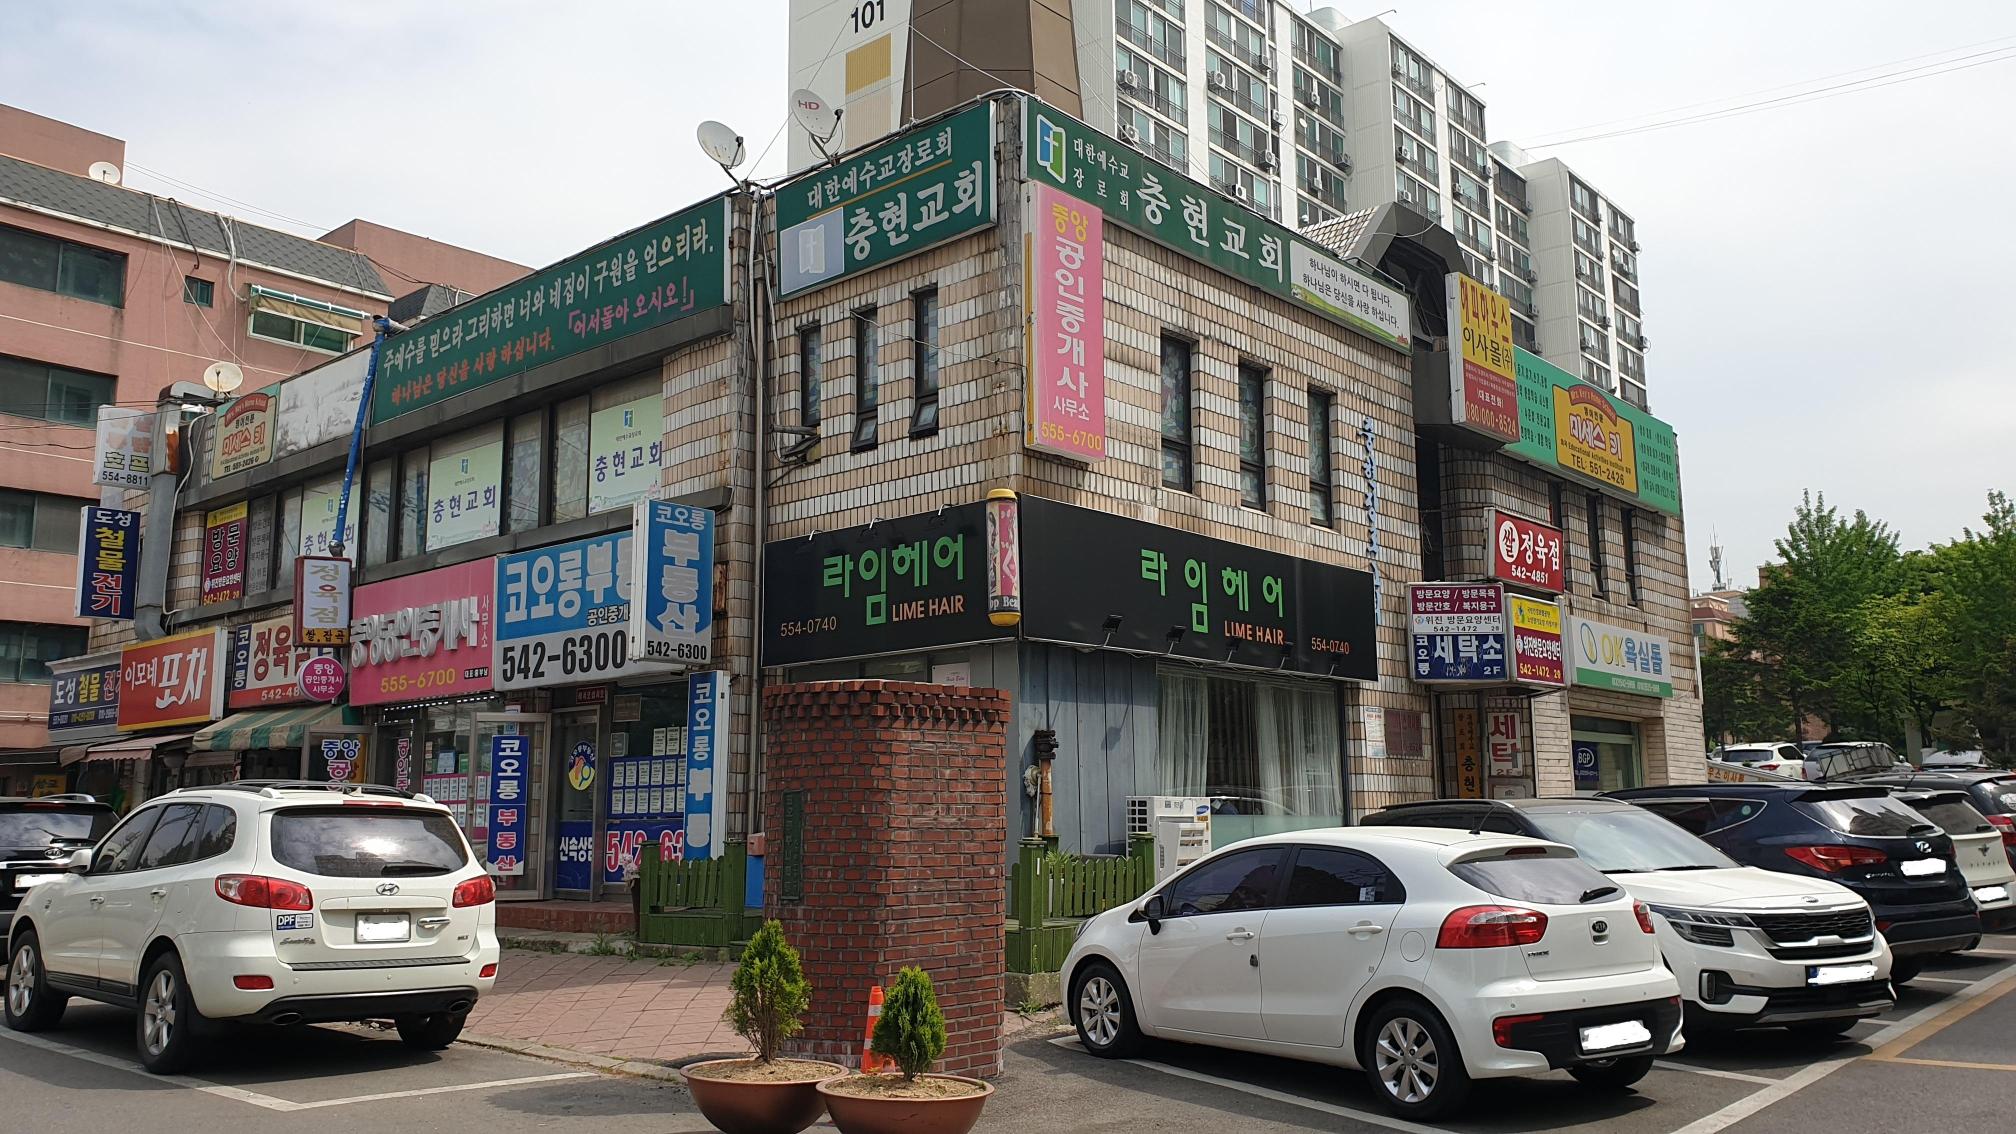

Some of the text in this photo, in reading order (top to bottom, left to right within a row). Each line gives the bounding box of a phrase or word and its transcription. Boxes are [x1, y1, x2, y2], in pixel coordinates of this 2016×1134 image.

[851, 0, 886, 34] 101
[798, 100, 820, 111] HD
[807, 126, 952, 209] 대한예수교장로회
[1073, 138, 1130, 180] 대한예수교
[845, 160, 983, 261] 충현교회
[1052, 203, 1089, 242] 중앙
[1136, 173, 1284, 284] 충현교회
[384, 217, 714, 378] 주예수를 믿으라 그리하면 너와 네집이 구원을 얻으리라.
[1303, 273, 1400, 329] 하나님은 당신을 사랑 하십니다.
[1310, 258, 1393, 308] 하나님이 하시면 다 됩니다.
[1055, 235, 1089, 399] 공인중개사
[1460, 277, 1510, 344] 해피하우스
[391, 372, 434, 406] 하나님은
[436, 359, 471, 390] 당신을
[473, 346, 498, 376] 사랑
[1053, 395, 1090, 421] 사무소
[1041, 421, 1102, 451] 555-6700
[1569, 412, 1607, 451] 미세스
[1609, 430, 1623, 463] 키
[102, 470, 149, 486] 554-8811
[104, 451, 150, 473] 호프
[595, 440, 662, 483] 충현교회
[1590, 461, 1625, 486] 551-2426
[94, 510, 131, 527] 도성
[432, 485, 497, 524] 충현교회
[656, 505, 706, 531] 코오롱
[95, 527, 126, 571] 철물
[303, 523, 355, 556] 충현회
[1502, 526, 1560, 572] 쌀 정육점
[505, 536, 632, 624] 코오롱부동
[656, 529, 700, 640] 부동산
[823, 533, 964, 626] 라임헤어
[1141, 549, 1284, 633] 라임헤어
[1416, 589, 1450, 599] 방문요양
[1462, 588, 1495, 599] 방문목욕
[1511, 563, 1549, 585] 542-4851
[91, 572, 123, 616] 전기
[310, 563, 343, 625] 정육점
[892, 594, 964, 622] LIME HAIR
[1416, 601, 1451, 611] 방문간호
[1462, 601, 1496, 611] 복지용구
[350, 596, 479, 669] 중앙공인중개사
[481, 593, 489, 648] 사무소
[587, 603, 630, 626] 공인중개
[779, 616, 837, 637] 554-0740
[1224, 620, 1285, 645] LIME HAIR
[1426, 614, 1501, 625] 위진 방문요양센터
[234, 629, 250, 688] 코오롱
[502, 630, 627, 683] 542-6300
[647, 640, 707, 661] 542-6300
[1311, 636, 1350, 655] 554-0740
[1416, 635, 1431, 676] 코오롱
[1434, 635, 1503, 664] 세탁소
[125, 647, 208, 709] 이모네 포차
[304, 675, 342, 684] 공인중개사
[313, 663, 335, 675] 중앙
[381, 668, 456, 693] 555-6700
[1483, 666, 1501, 675] 2F
[1520, 662, 1550, 678] 542-1472
[54, 677, 76, 705] 도성
[78, 673, 101, 704] 철물
[261, 686, 299, 701] 542-48
[312, 685, 335, 694] 사무소
[693, 682, 712, 761] 코오롱
[1490, 714, 1520, 768] 세탁
[321, 739, 361, 760] 중앙
[1578, 752, 1591, 764] BGP
[497, 739, 522, 800] 코오롱
[1461, 755, 1476, 799] 충현
[496, 808, 519, 872] 부동산
[278, 915, 295, 926] DPF
